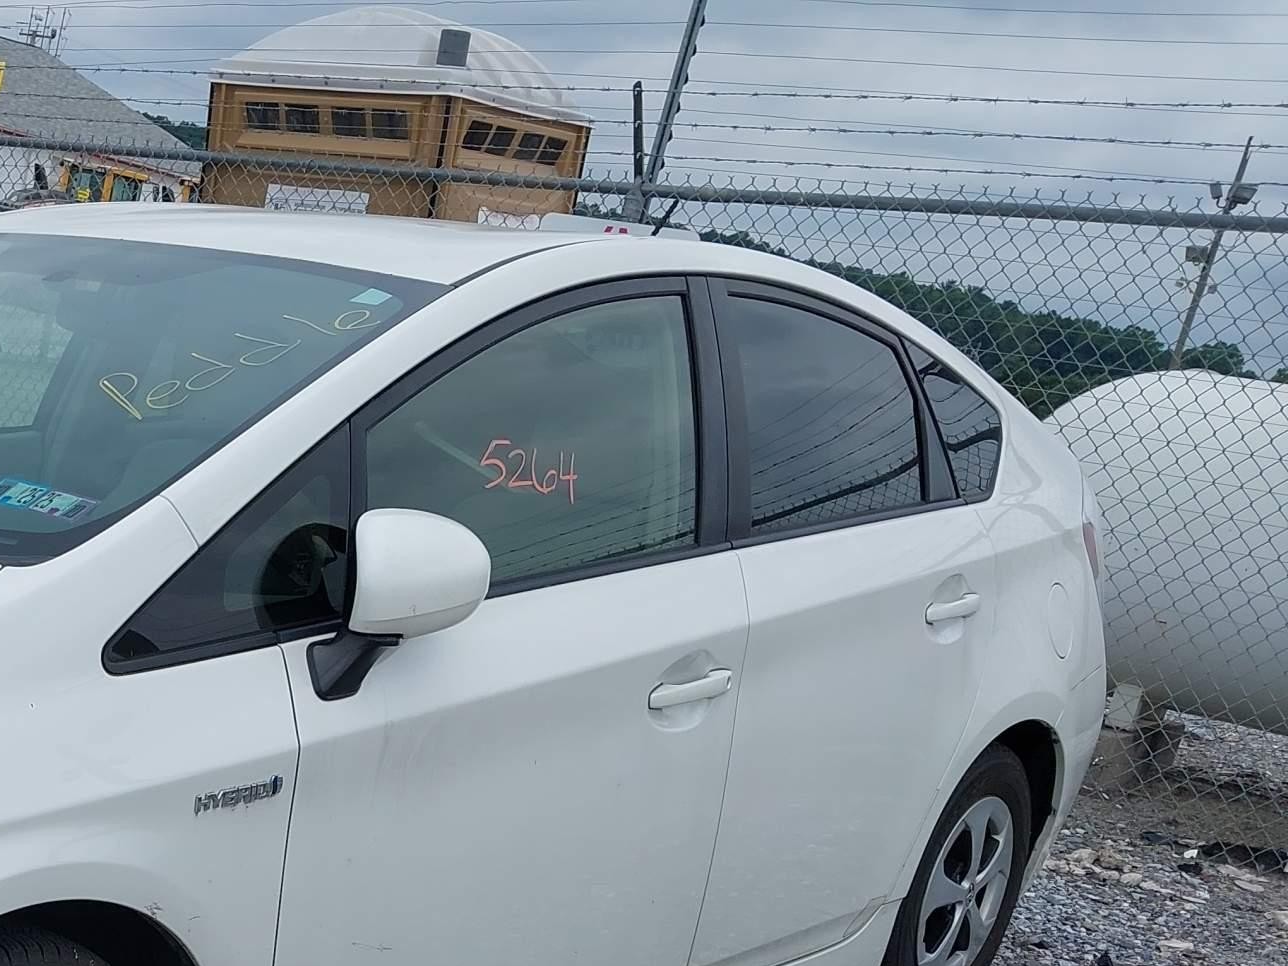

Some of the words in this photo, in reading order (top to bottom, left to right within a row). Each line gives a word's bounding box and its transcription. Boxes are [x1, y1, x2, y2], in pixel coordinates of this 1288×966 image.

[99, 309, 381, 420] Peddle
[480, 439, 578, 505] 5264
[194, 780, 272, 816] HYBRID
